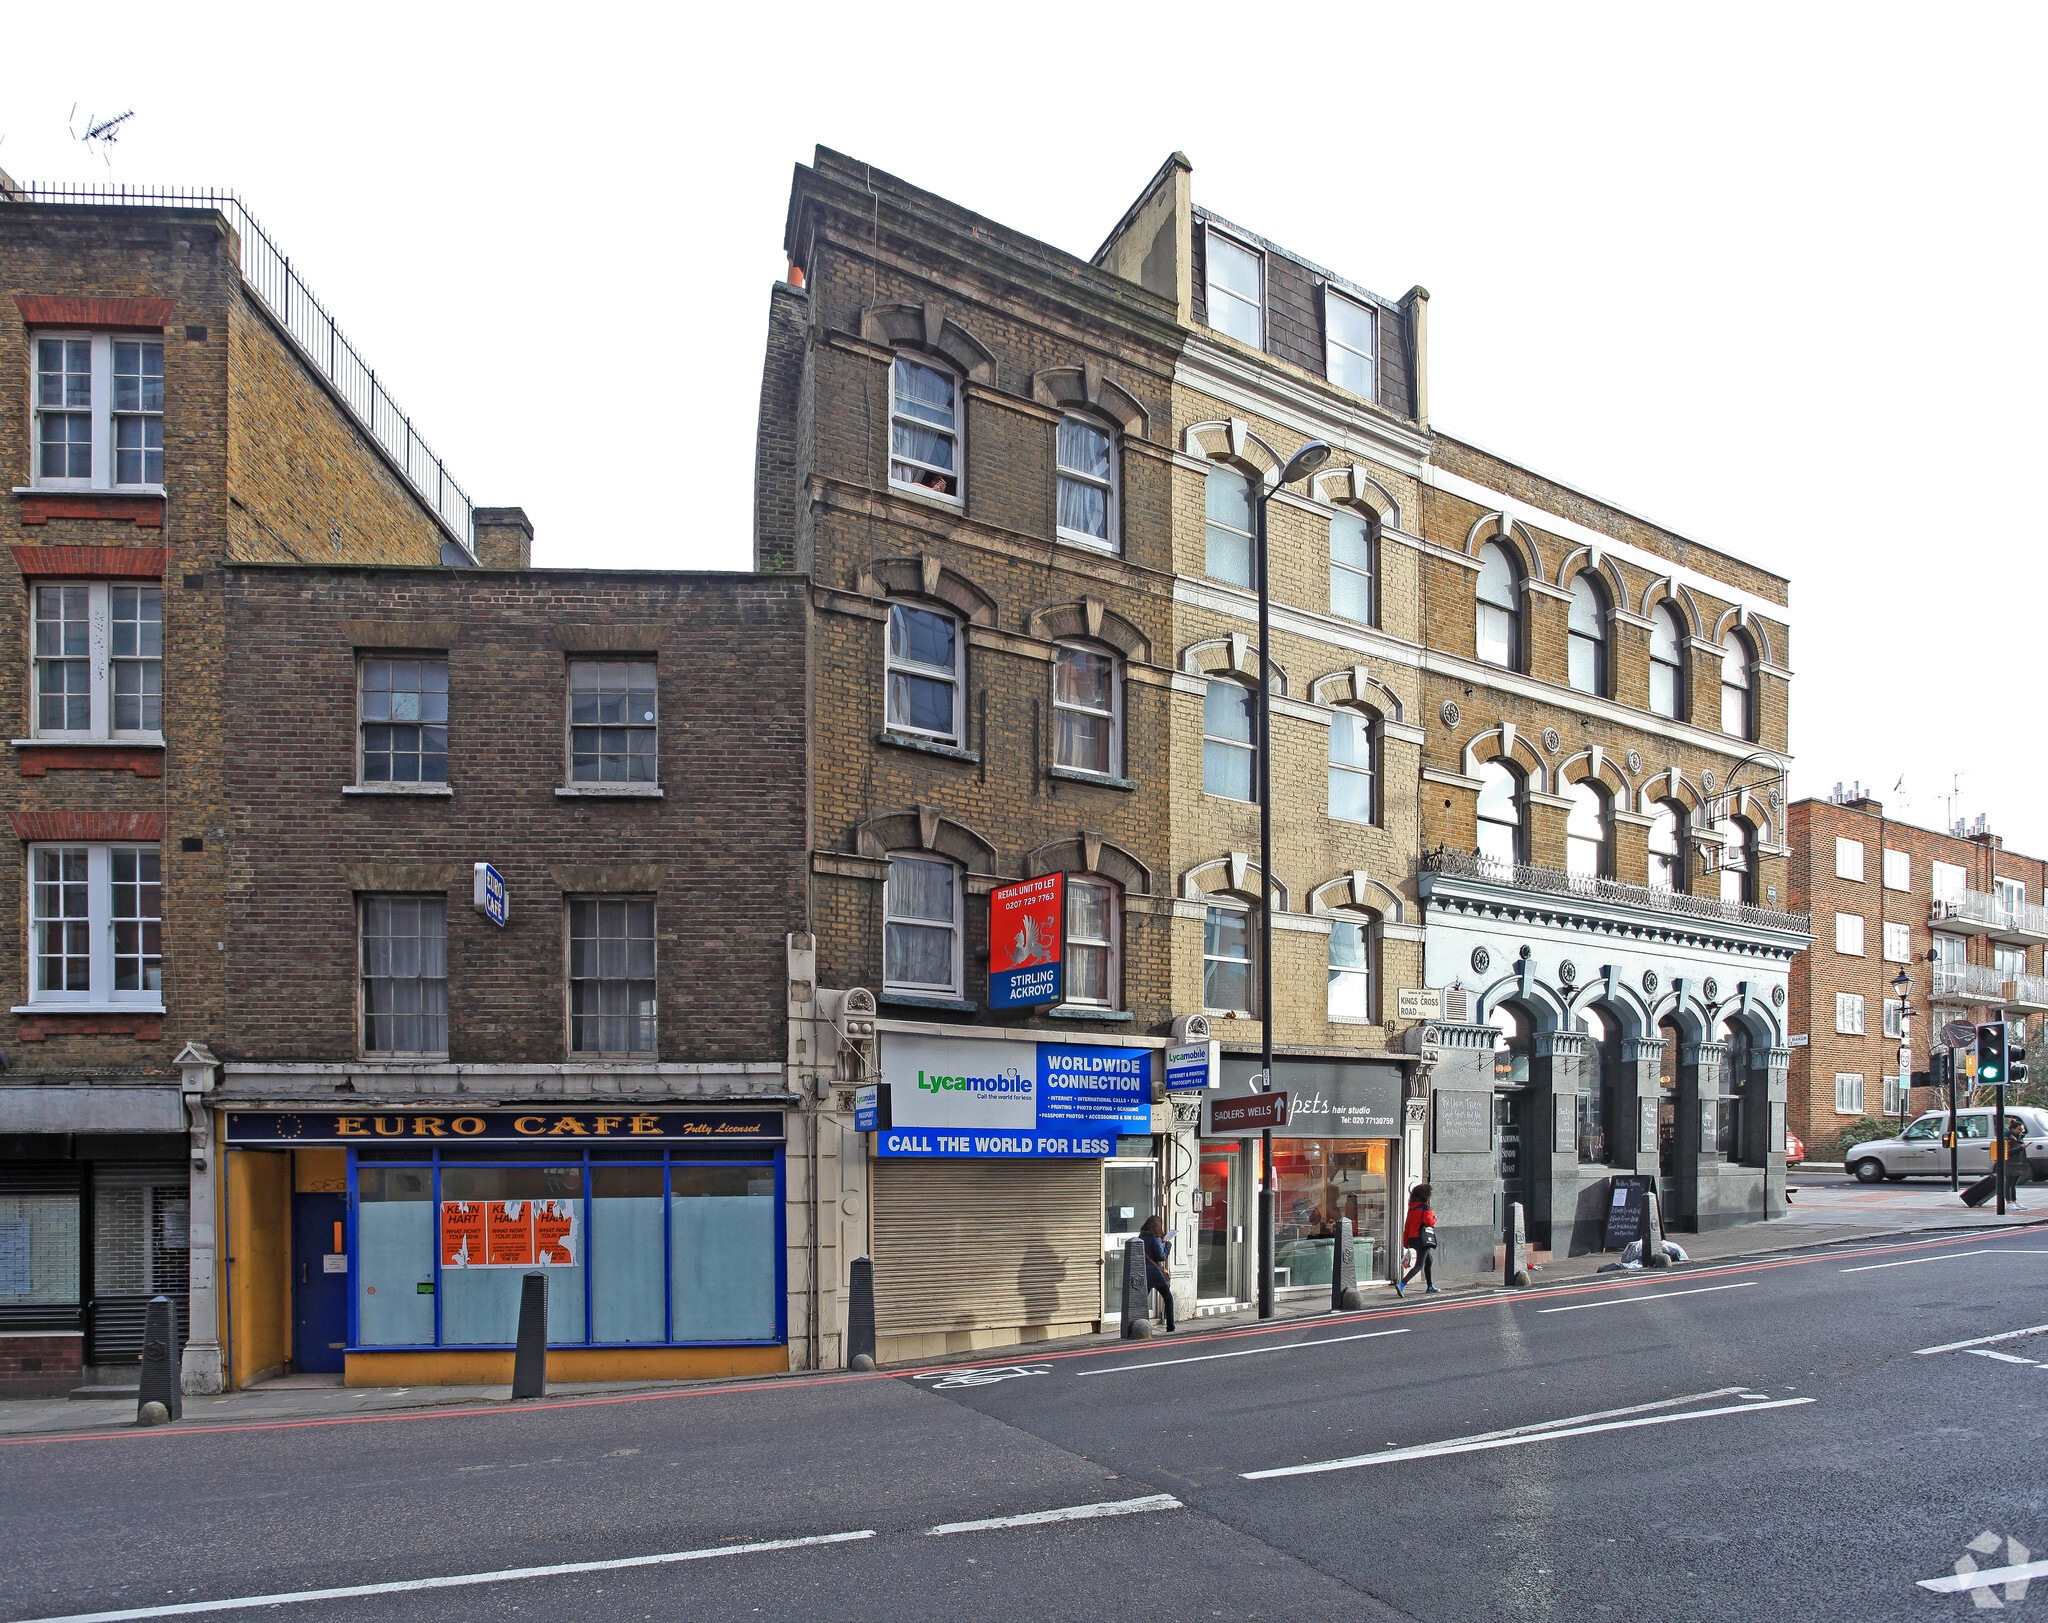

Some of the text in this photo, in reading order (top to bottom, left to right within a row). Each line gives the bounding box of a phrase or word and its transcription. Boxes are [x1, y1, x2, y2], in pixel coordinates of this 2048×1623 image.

[487, 871, 503, 899] EURO
[998, 878, 1055, 900] RETAIL UNIT TO LET
[1005, 892, 1054, 910] 0207 729 7763
[1010, 970, 1054, 987] STIRLING
[1009, 983, 1054, 1000] ACKROYD
[1401, 997, 1439, 1007] KINGS CROSS
[1401, 1008, 1417, 1016] ROAD
[1169, 1047, 1206, 1063] Lycamobile
[1047, 1055, 1141, 1074] WORLDWIDE
[918, 1067, 1033, 1094] Lycamobile
[1047, 1073, 1141, 1091] CONNECTION
[1214, 1106, 1271, 1121] SADLERS WELLS
[1332, 1106, 1346, 1114] hair
[1348, 1106, 1371, 1114] studio
[334, 1113, 761, 1136] EURO CAFÉ Fully Licensed
[1365, 1117, 1394, 1125] 77130759
[888, 1135, 1109, 1154] CALL THE WORLD FOR LESS
[447, 1205, 480, 1214] KEIN
[493, 1204, 525, 1214] KEN
[448, 1214, 479, 1224] HART
